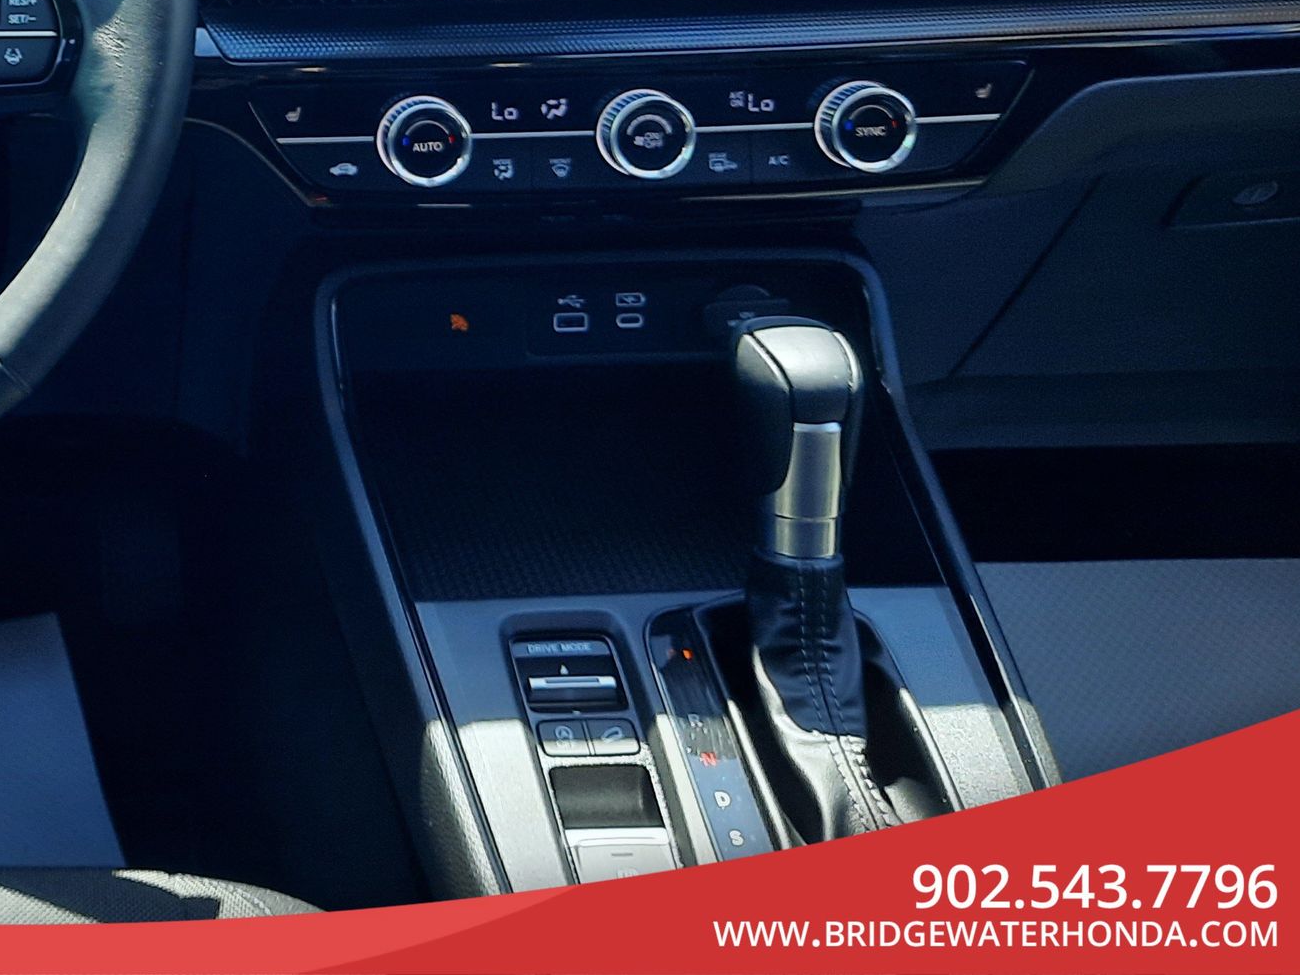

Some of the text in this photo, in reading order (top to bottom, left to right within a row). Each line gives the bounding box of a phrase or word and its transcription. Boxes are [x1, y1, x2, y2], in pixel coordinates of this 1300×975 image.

[854, 124, 887, 138] SYNC
[412, 141, 443, 154] AUTO
[768, 154, 789, 166] A/C
[527, 642, 591, 654] DRIVE MODE
[700, 752, 717, 768] N
[714, 790, 732, 808] D
[729, 829, 745, 847] S
